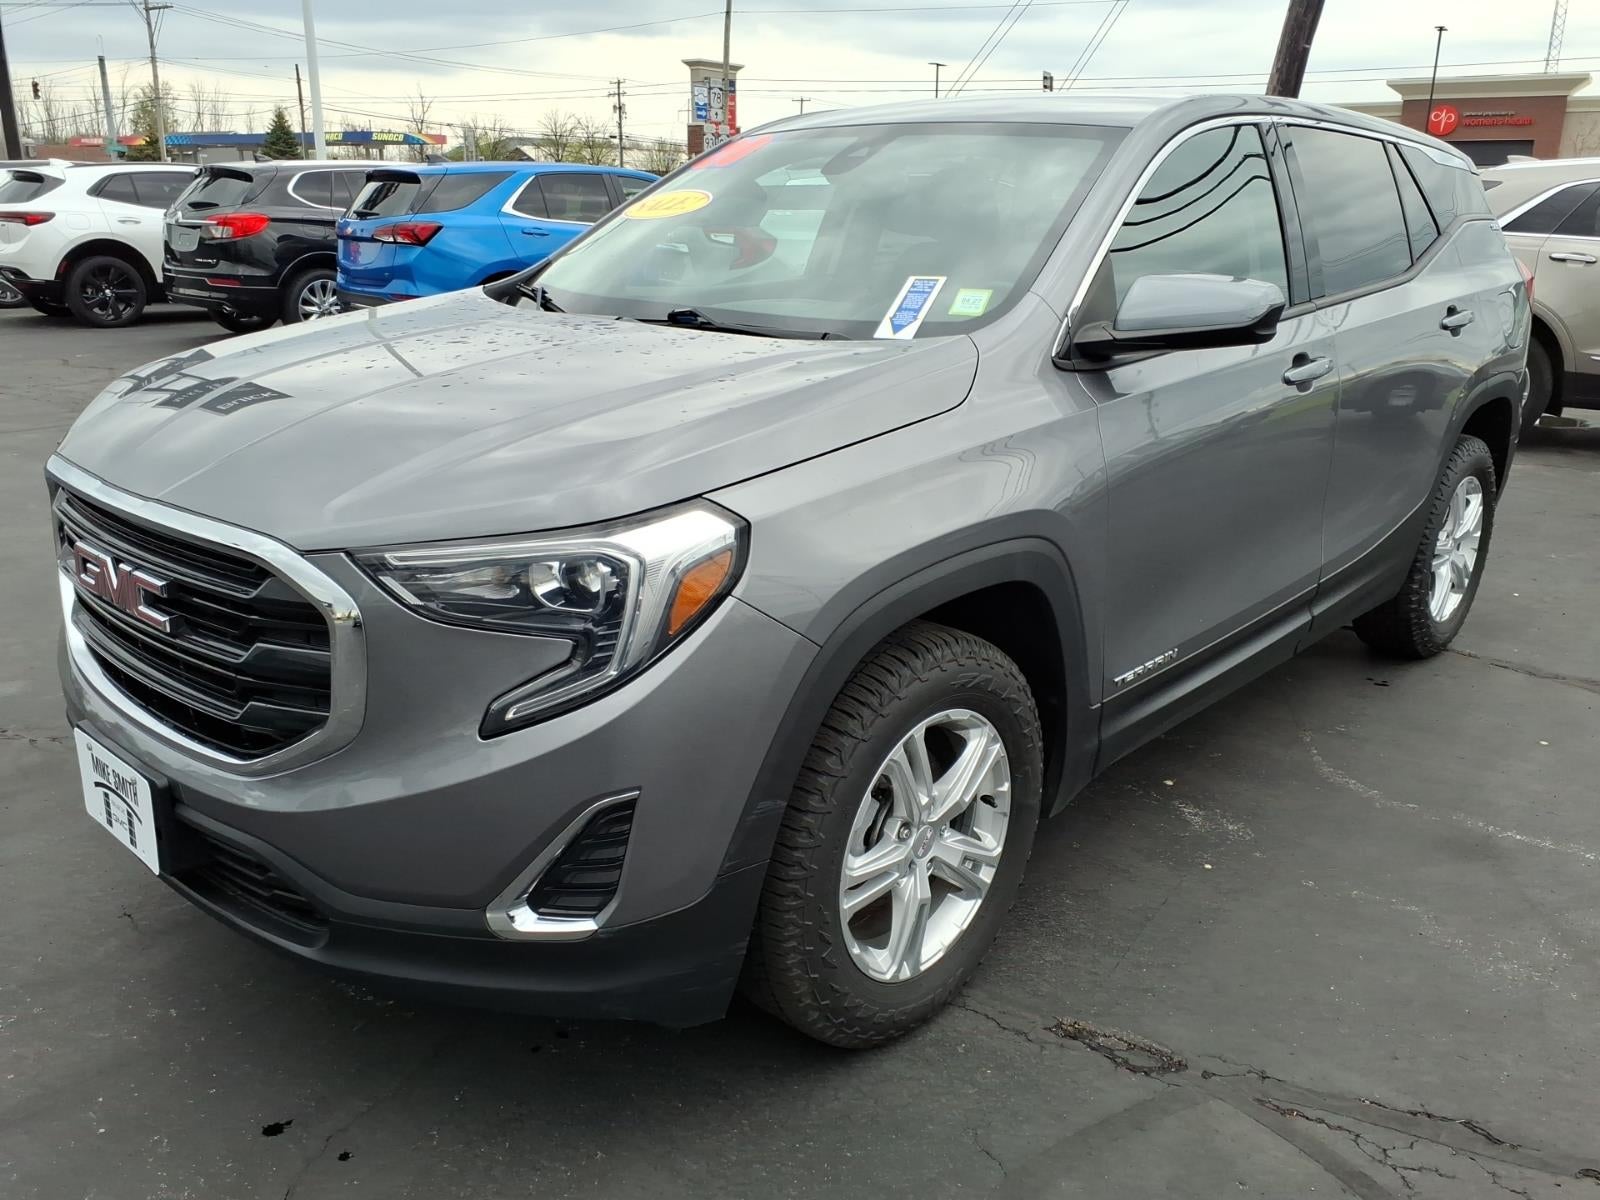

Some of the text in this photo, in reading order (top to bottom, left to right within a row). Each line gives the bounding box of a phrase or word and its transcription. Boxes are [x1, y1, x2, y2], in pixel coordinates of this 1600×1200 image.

[372, 132, 404, 142] SUNOCO
[73, 541, 172, 633] GMC
[1113, 647, 1179, 687] TERRAIN
[90, 752, 112, 785] MIKE
[112, 768, 140, 808] SMITH
